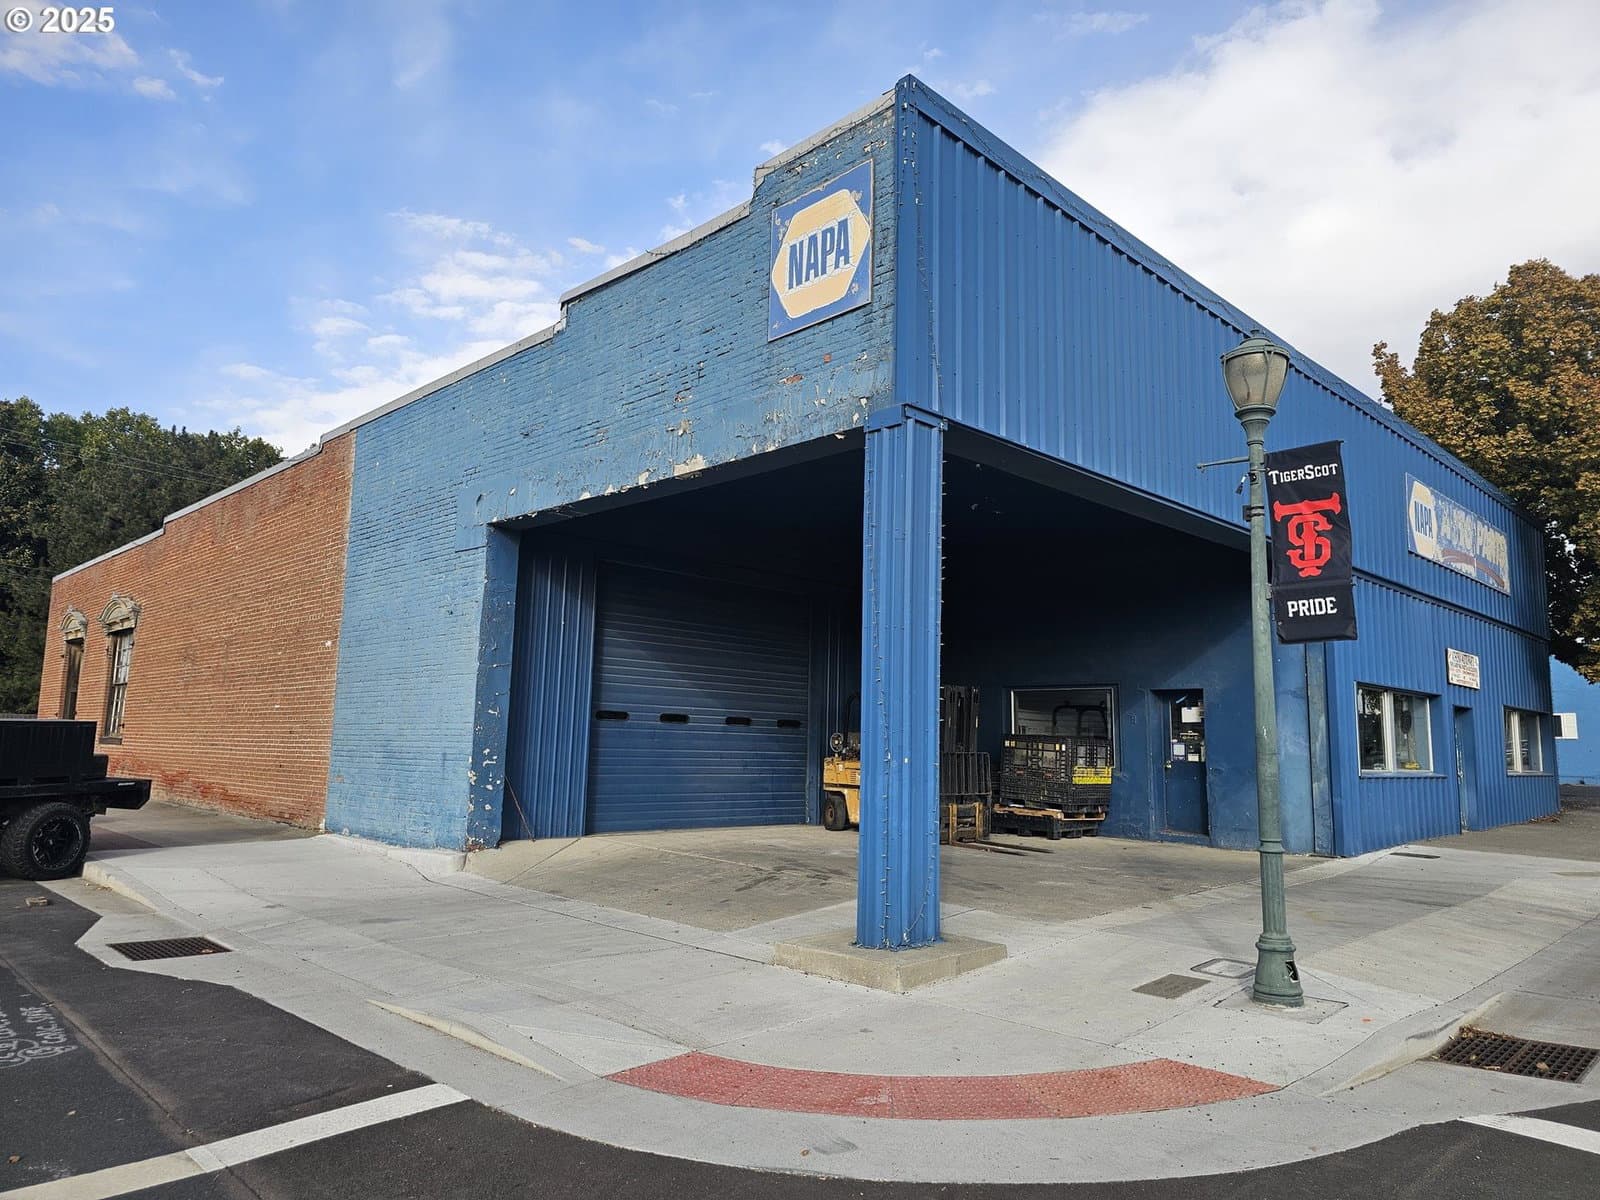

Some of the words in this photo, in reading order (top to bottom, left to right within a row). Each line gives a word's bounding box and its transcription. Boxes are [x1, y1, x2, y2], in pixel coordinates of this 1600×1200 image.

[788, 218, 850, 290] NAPA
[1414, 500, 1434, 540] NAPA
[1287, 597, 1338, 618] PRIDE
